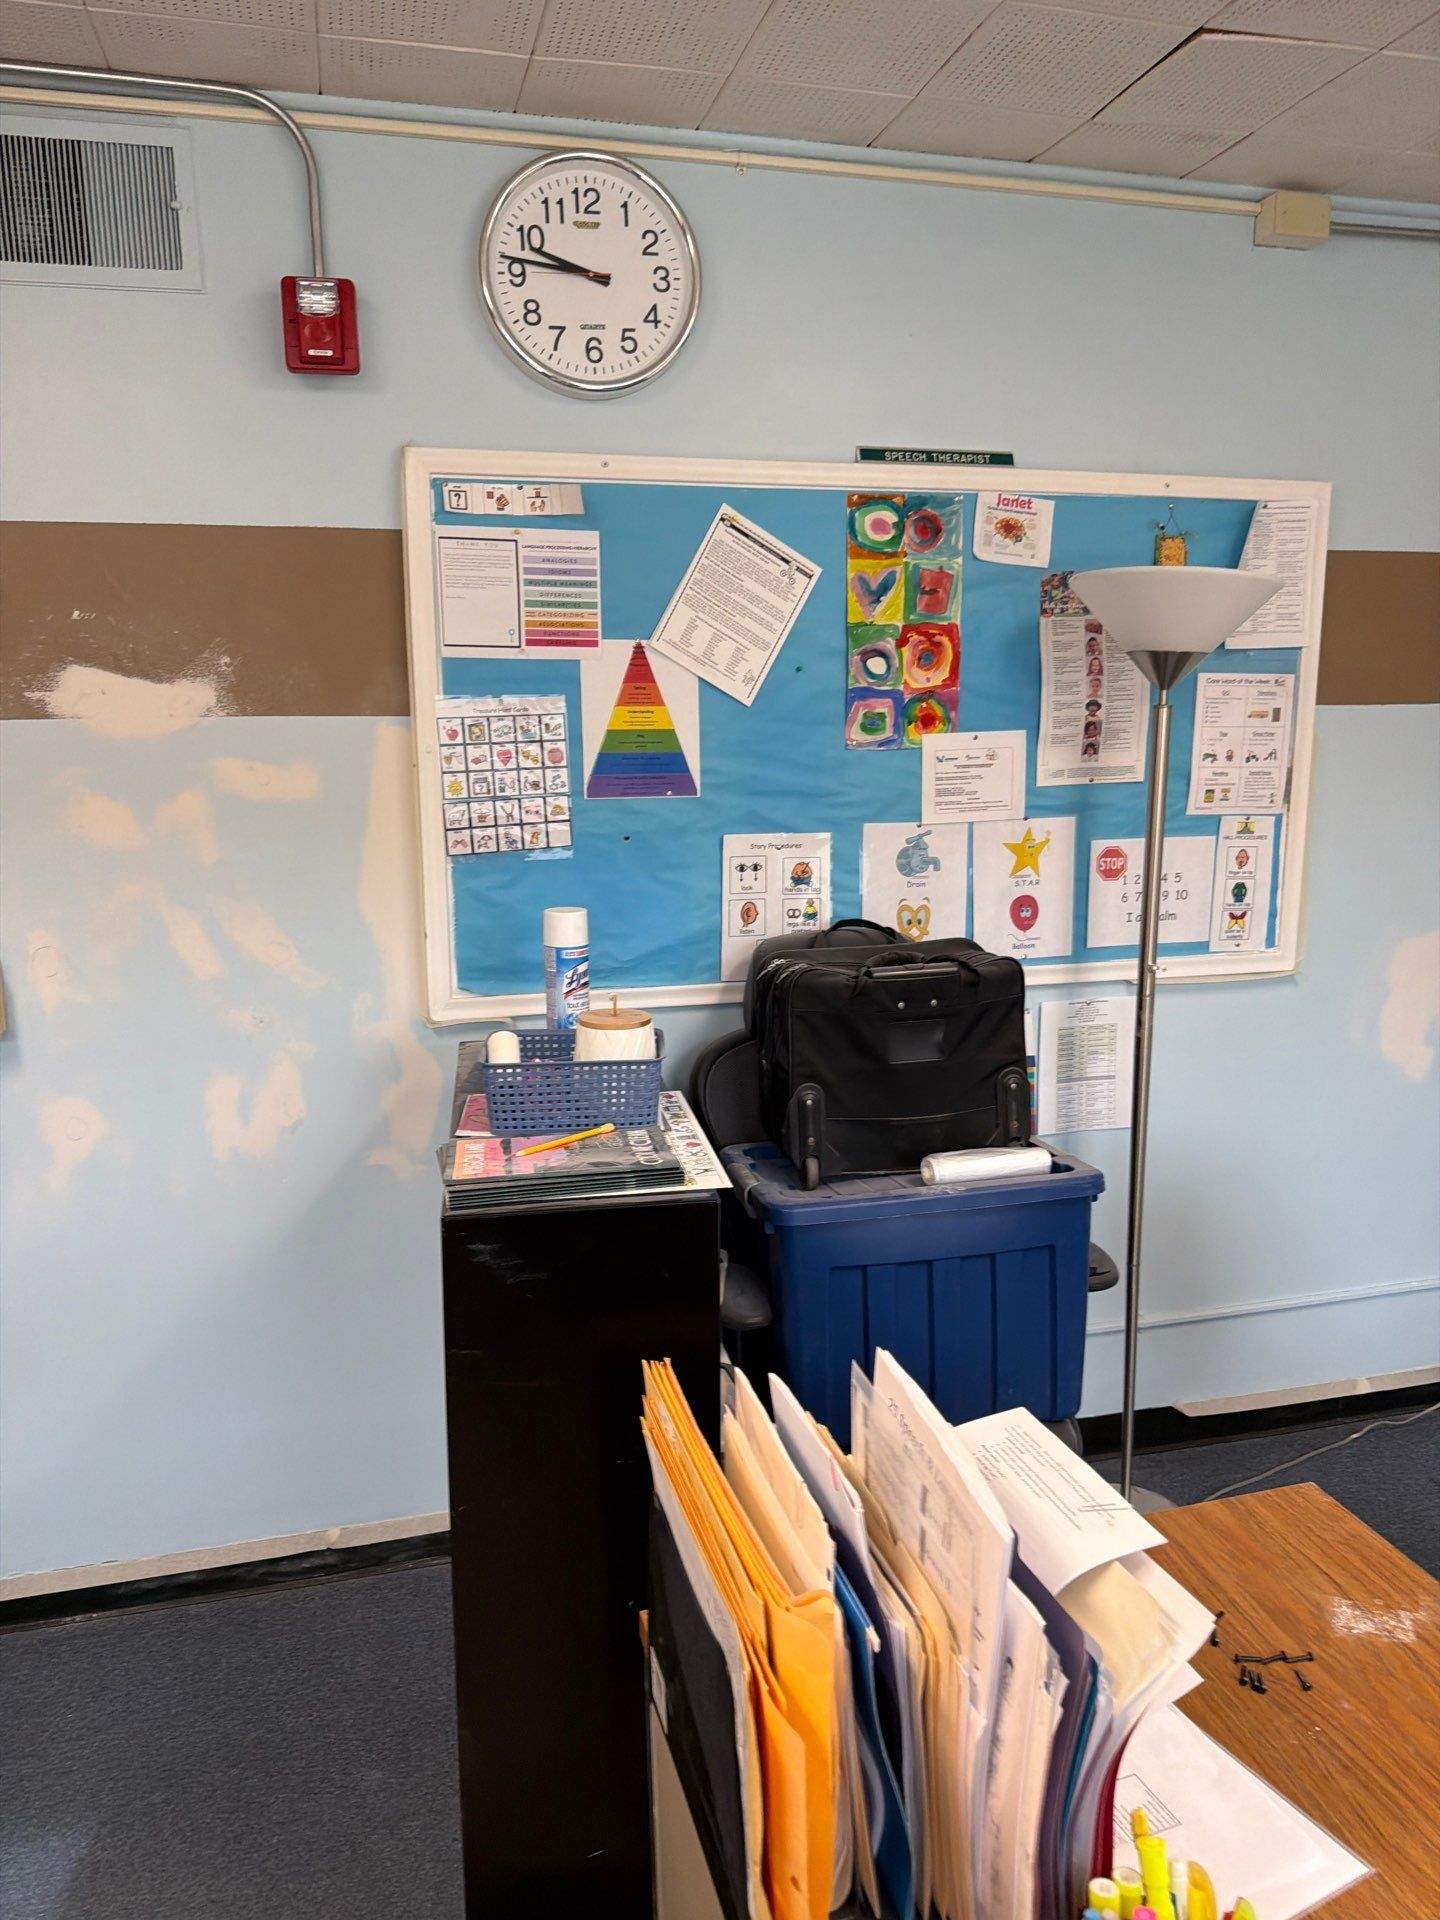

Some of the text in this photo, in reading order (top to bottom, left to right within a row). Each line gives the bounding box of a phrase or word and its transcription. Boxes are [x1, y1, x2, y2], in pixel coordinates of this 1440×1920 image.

[541, 196, 565, 224] 11
[571, 187, 601, 215] 12
[620, 200, 629, 227] 1
[516, 224, 545, 251] 10
[641, 229, 659, 256] 2
[507, 259, 527, 287] 9
[652, 265, 671, 293] 3
[522, 298, 542, 326] 8
[643, 303, 662, 329] 4
[548, 325, 567, 352] 7
[585, 336, 603, 364] 6
[620, 327, 638, 354] 5
[884, 451, 992, 464] SPEECH THERAPIST
[767, 842, 803, 851] Proedures
[1099, 857, 1125, 871] STOP
[1122, 872, 1182, 885] 1 2 4 5
[1121, 889, 1189, 903] 6 7 9 10
